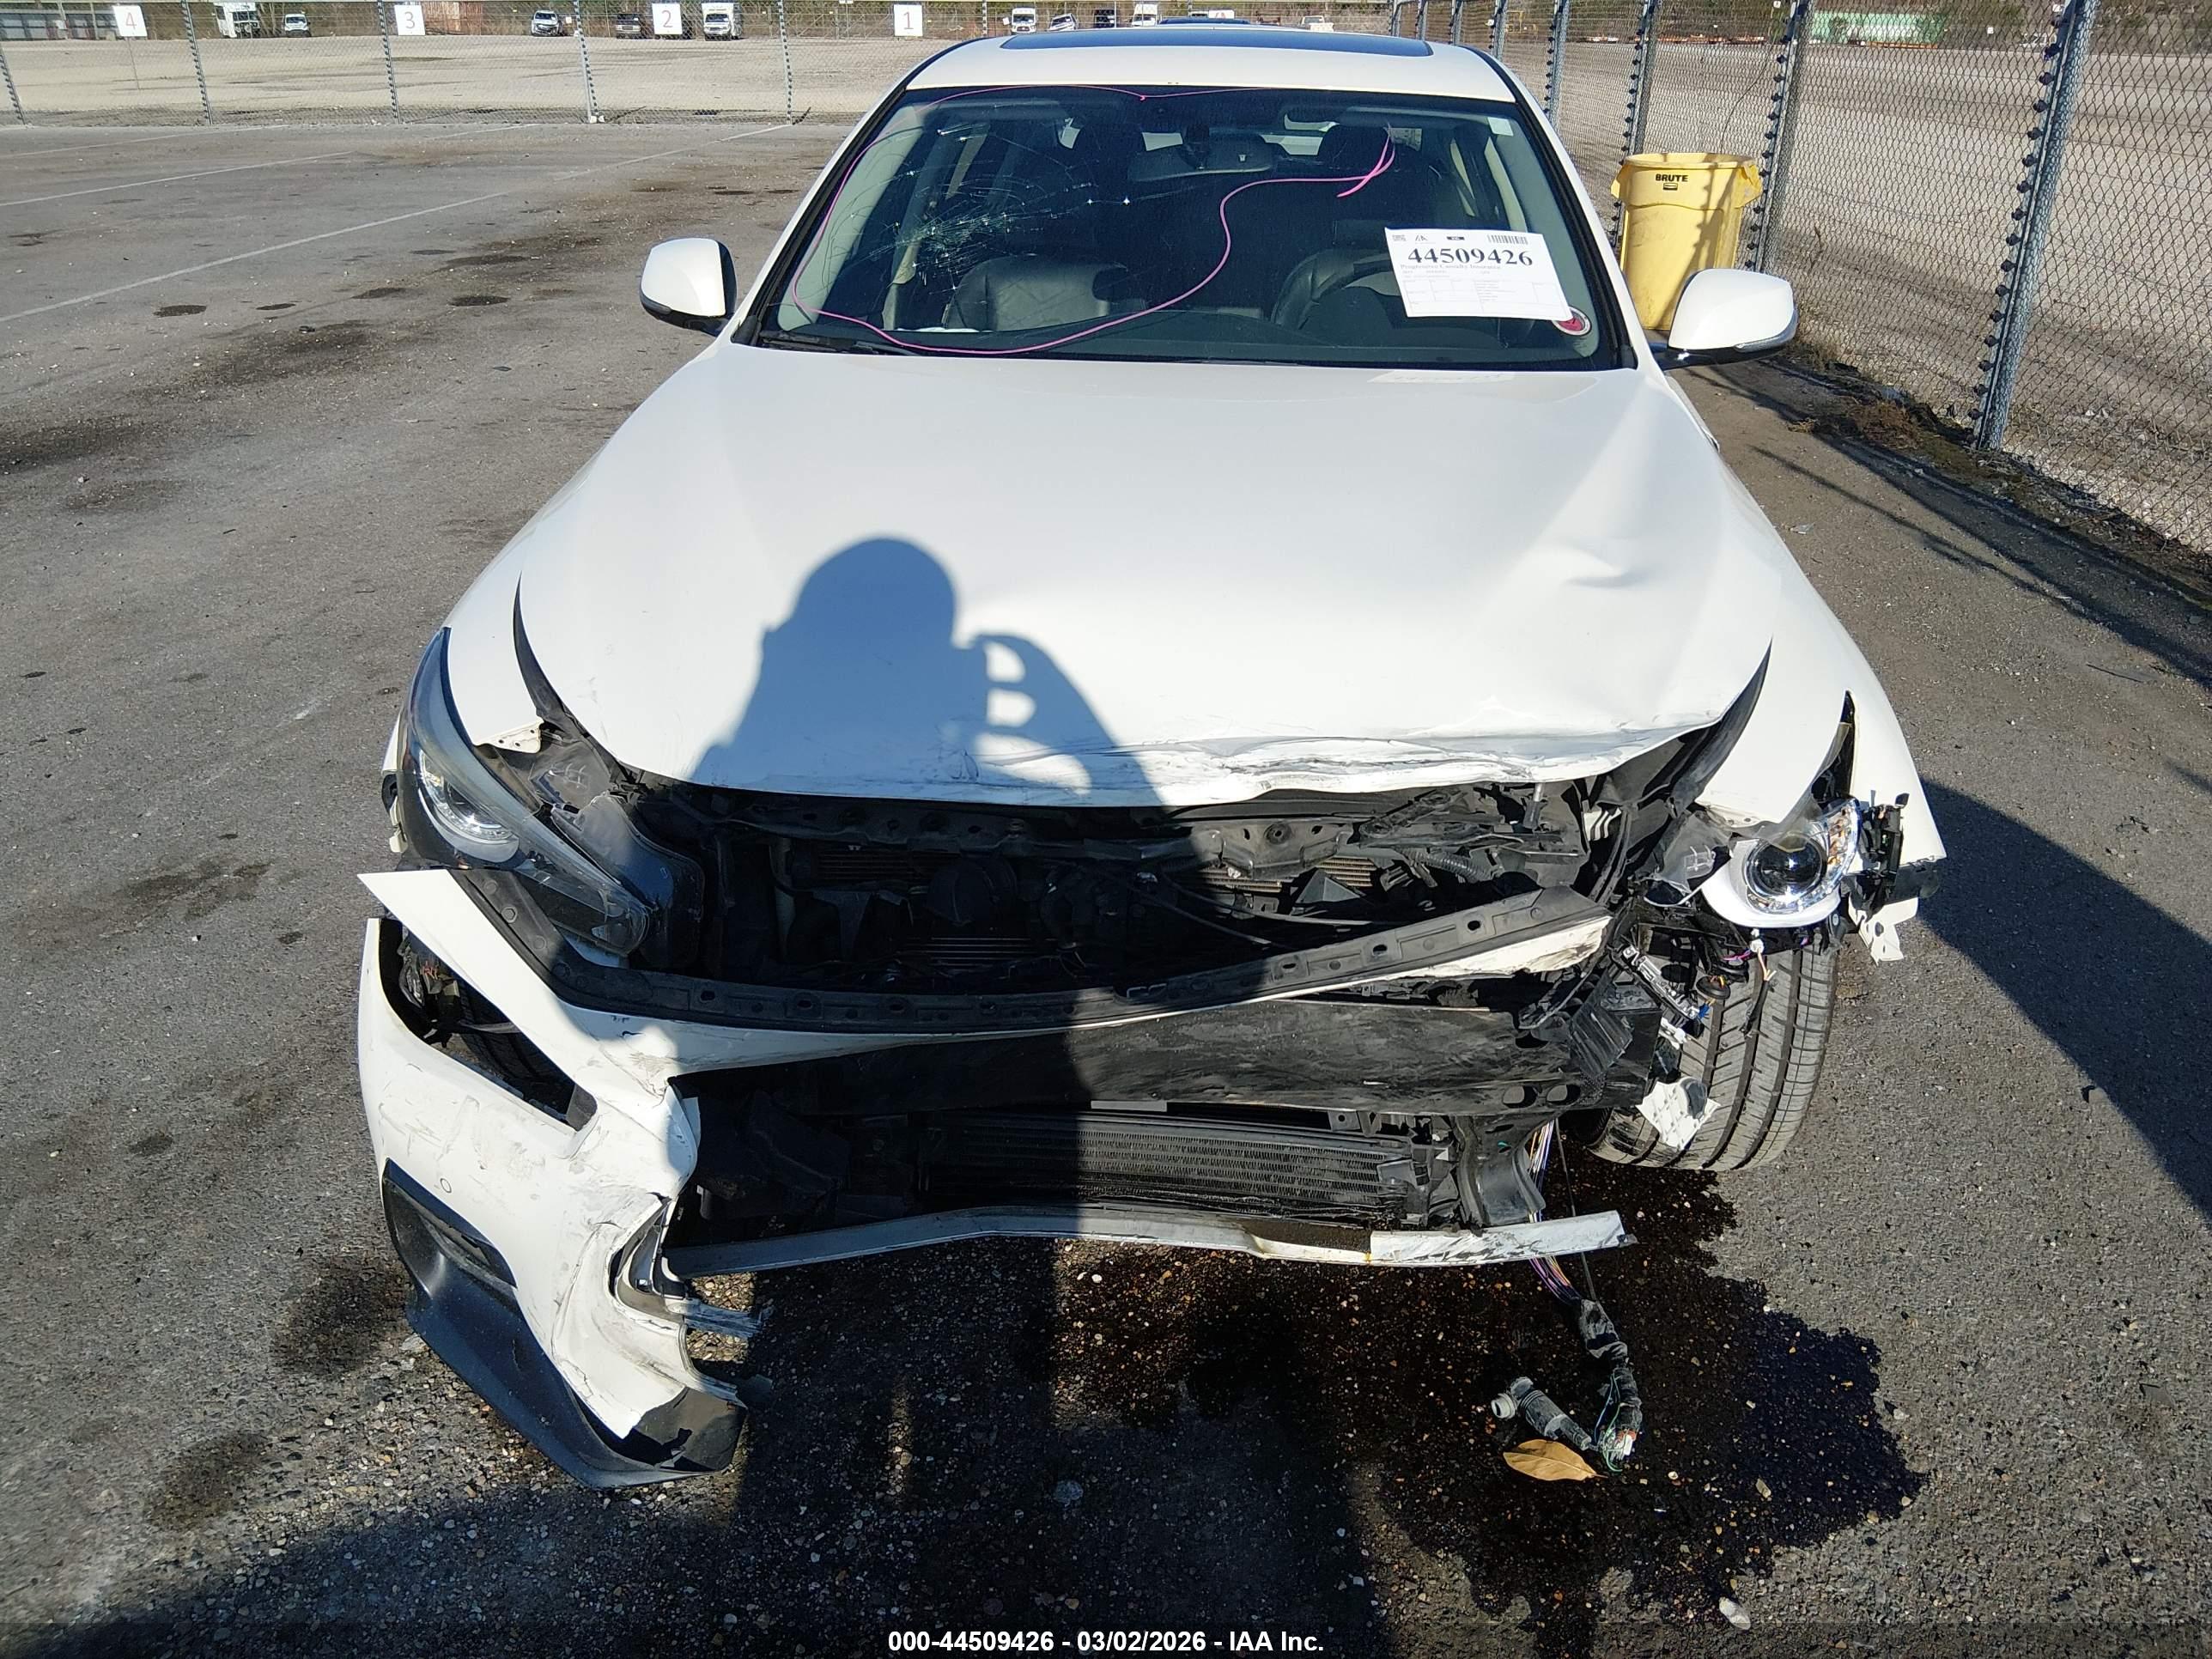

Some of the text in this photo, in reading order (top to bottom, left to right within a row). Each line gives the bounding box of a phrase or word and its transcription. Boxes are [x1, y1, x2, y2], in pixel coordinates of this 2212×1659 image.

[125, 12, 137, 30] 4
[404, 11, 416, 29] 3
[661, 9, 673, 27] 2
[903, 11, 914, 29] 1
[1655, 173, 1689, 182] BRUTE
[1407, 248, 1533, 266] 44509426
